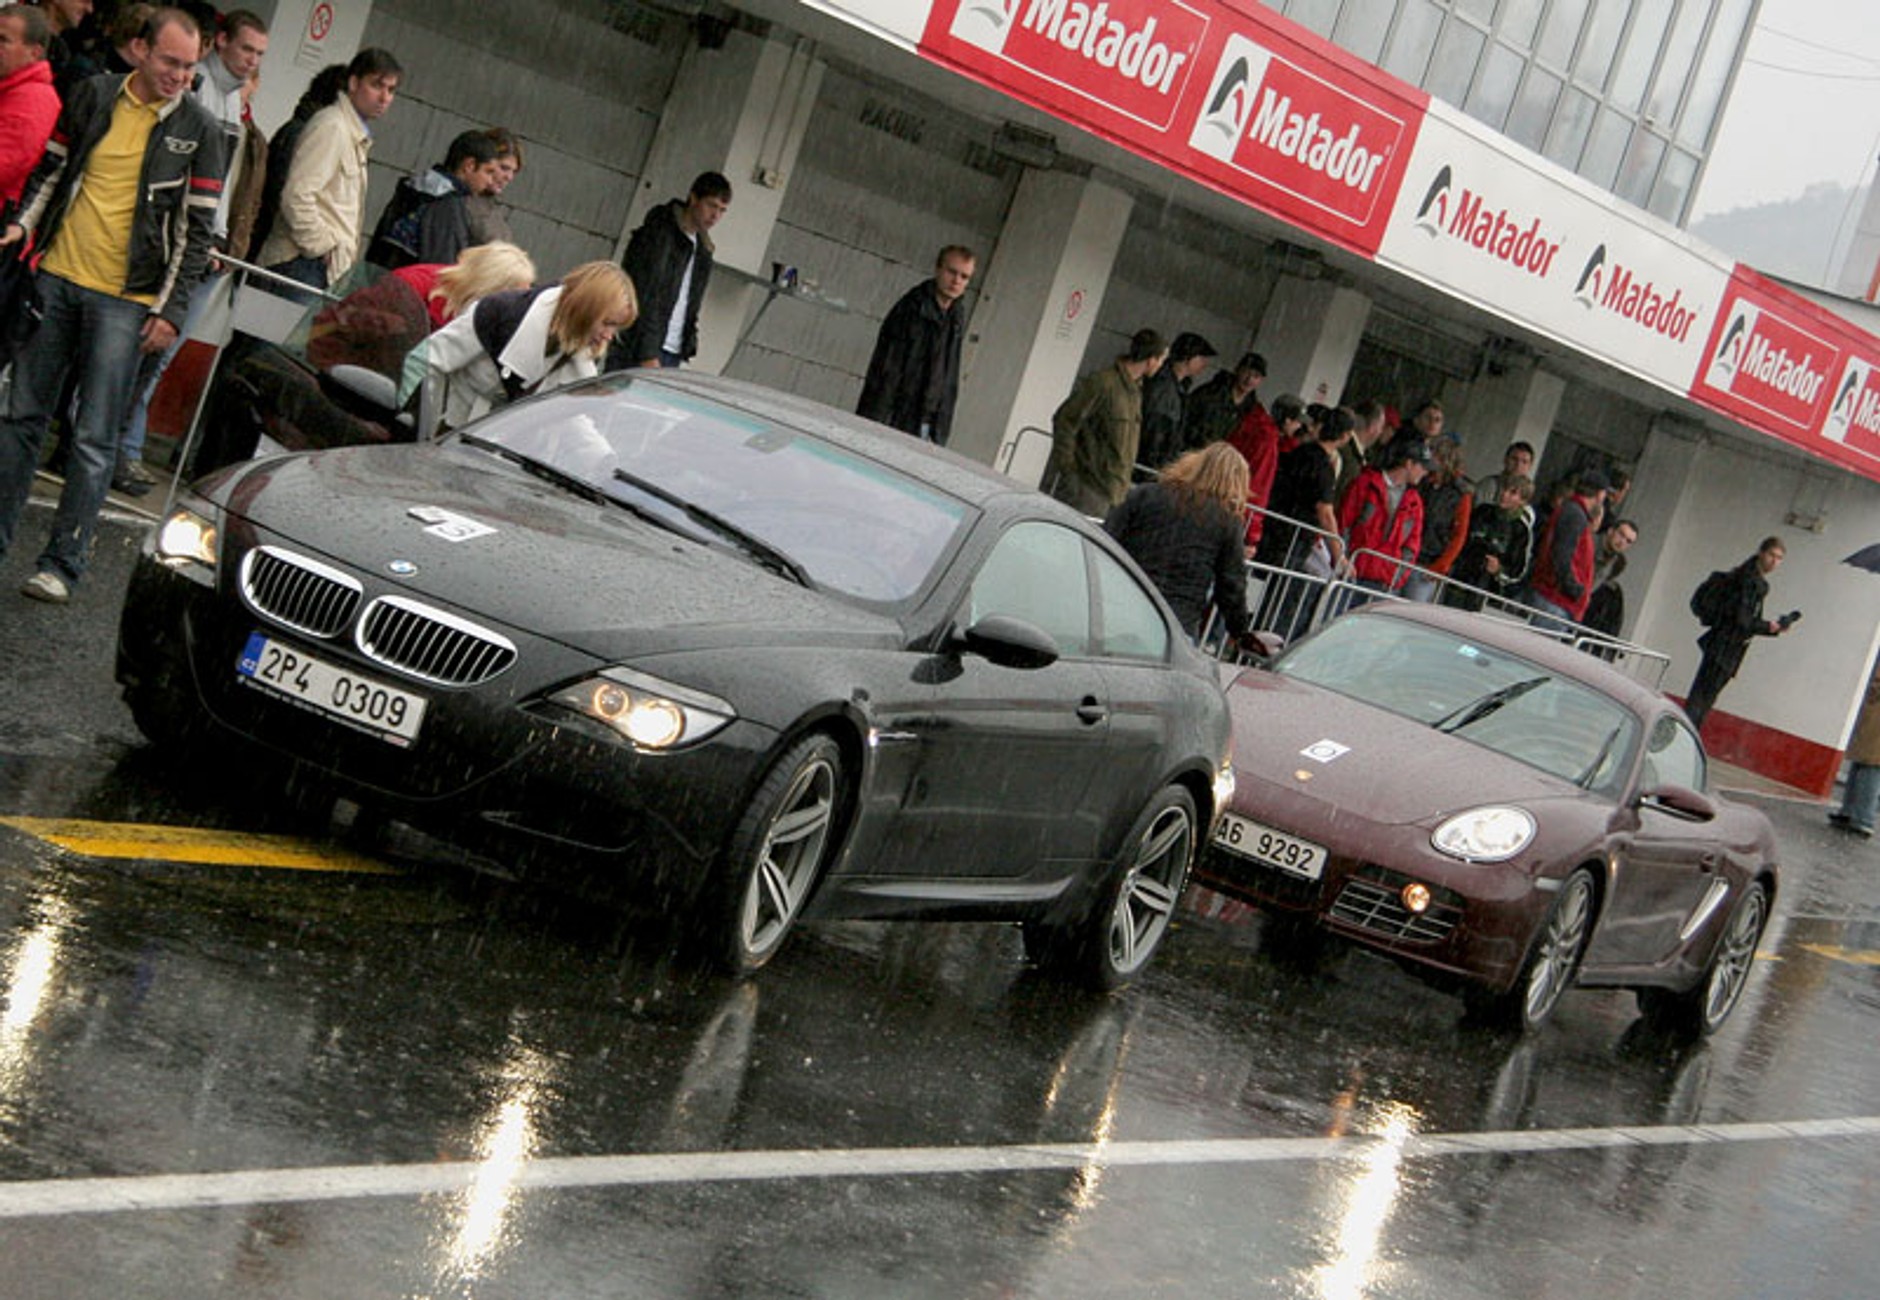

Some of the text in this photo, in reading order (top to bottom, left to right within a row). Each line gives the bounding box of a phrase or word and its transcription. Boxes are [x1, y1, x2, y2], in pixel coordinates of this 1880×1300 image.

[1022, 0, 1177, 95] Matador
[1249, 86, 1384, 193] Matador
[1448, 188, 1560, 278] Matador
[1601, 264, 1696, 343] Matador
[1741, 333, 1824, 405] Matador
[261, 648, 408, 728] 2P4 0309
[1257, 833, 1315, 872] 9292
